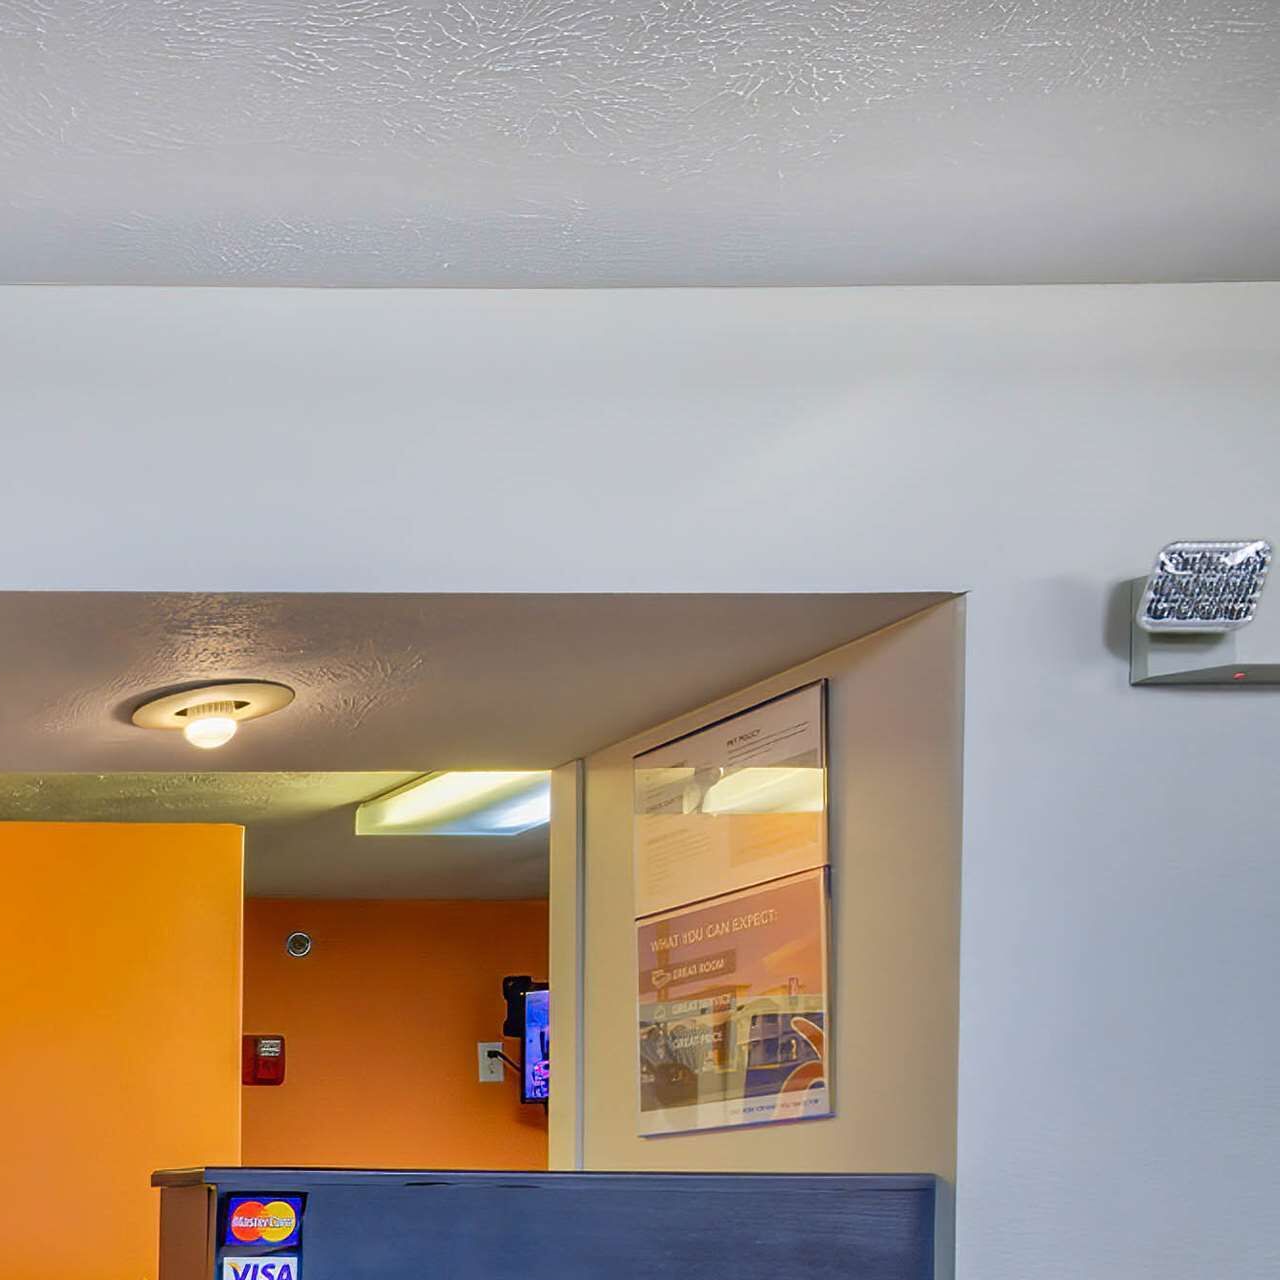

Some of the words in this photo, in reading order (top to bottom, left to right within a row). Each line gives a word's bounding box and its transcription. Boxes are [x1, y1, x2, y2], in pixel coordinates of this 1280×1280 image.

[650, 933, 679, 952] WHAT
[682, 927, 704, 944] YOU
[706, 920, 730, 938] CAN
